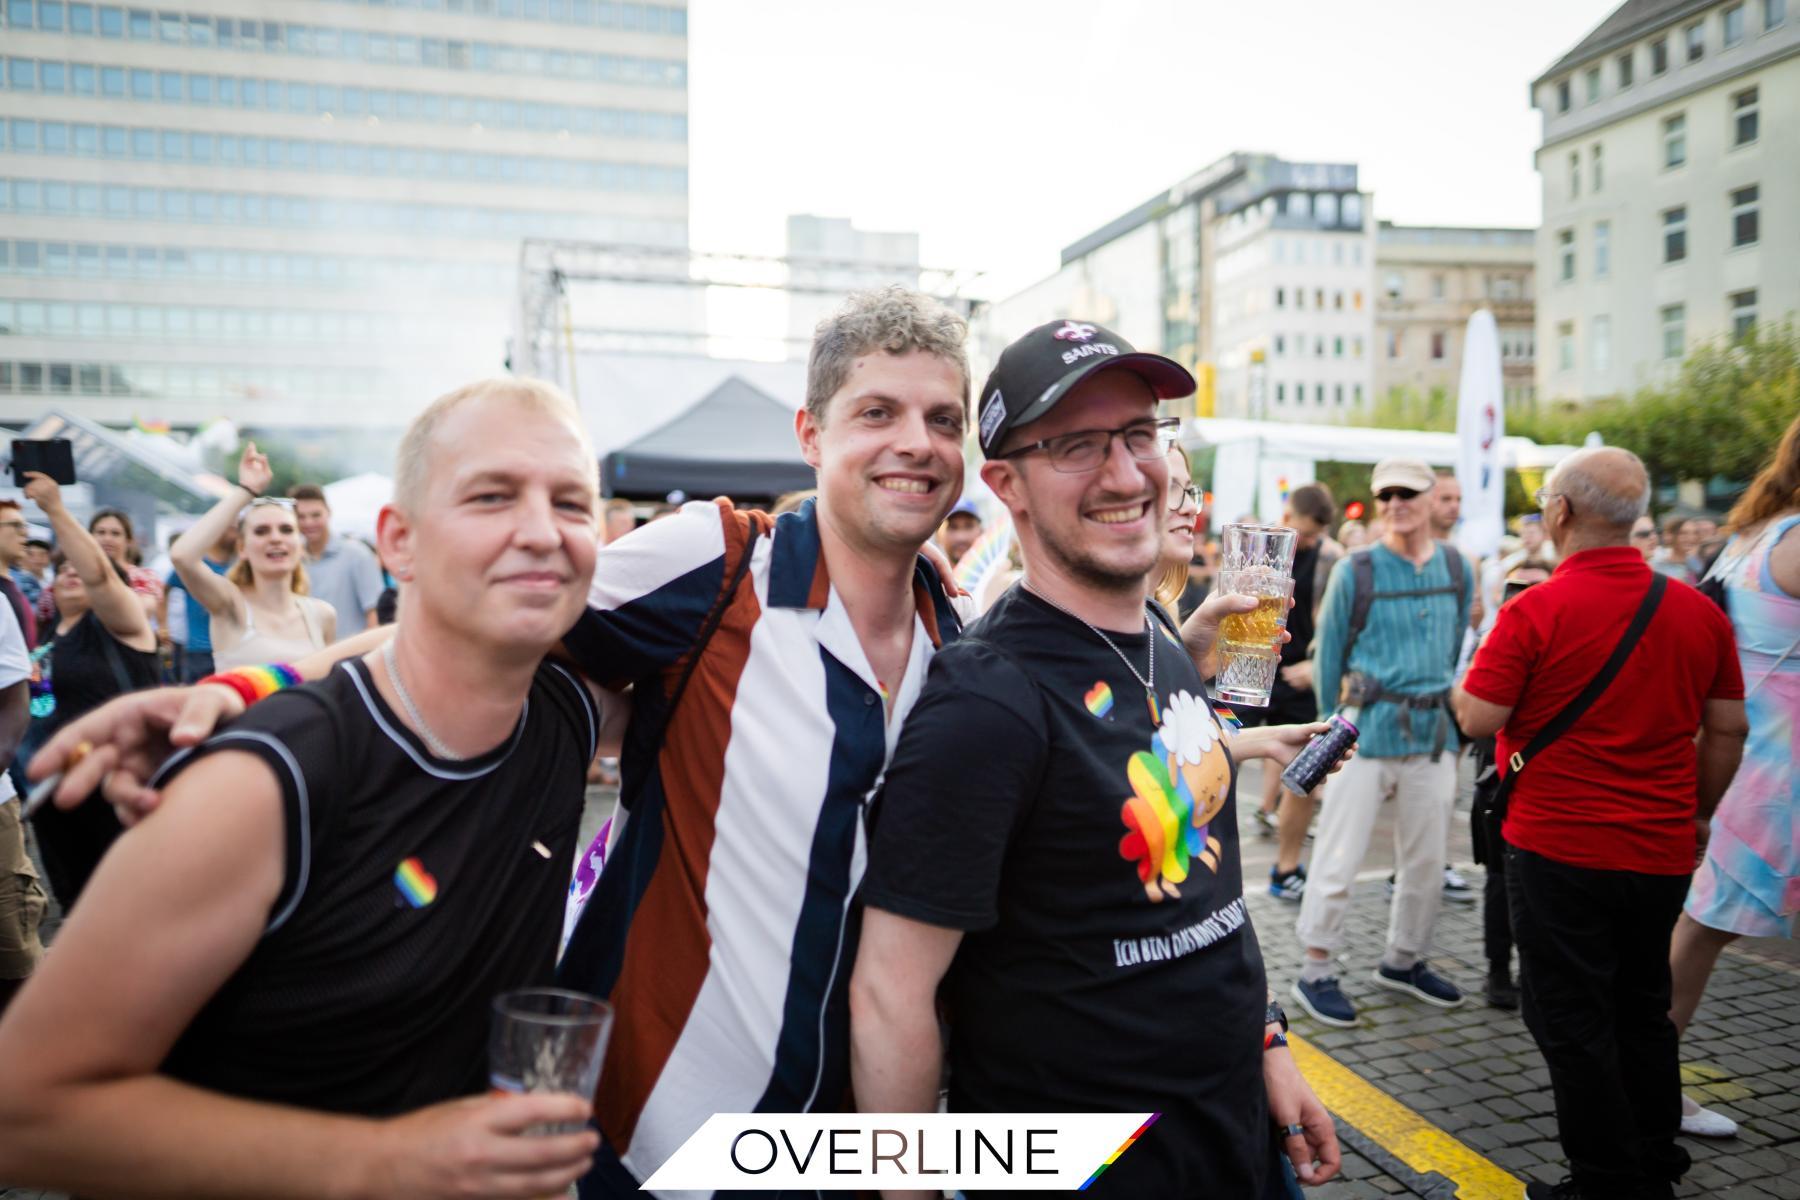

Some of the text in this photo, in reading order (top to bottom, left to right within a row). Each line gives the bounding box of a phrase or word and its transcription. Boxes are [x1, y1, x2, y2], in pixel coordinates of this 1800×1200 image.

[1061, 343, 1119, 365] SAINTS
[1113, 938, 1142, 967] ICH
[1140, 935, 1172, 962] BIN
[1171, 928, 1196, 958] DAS
